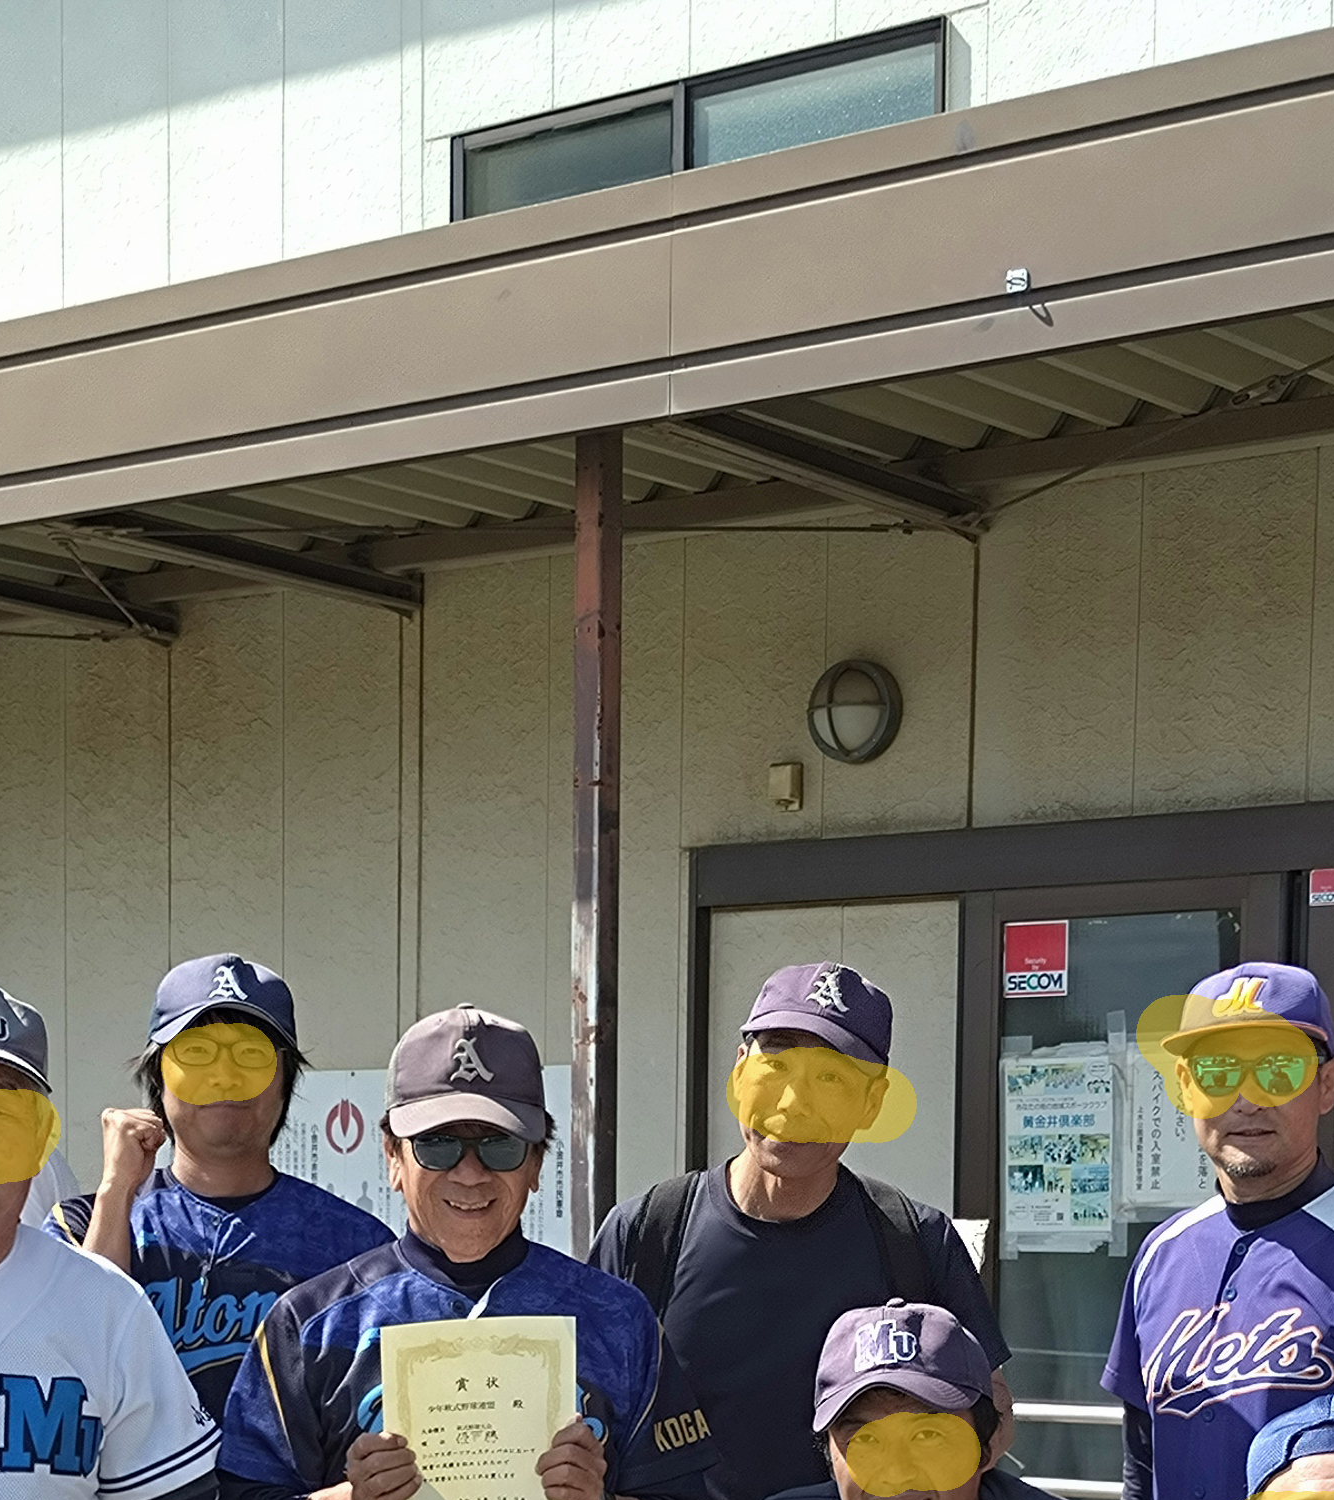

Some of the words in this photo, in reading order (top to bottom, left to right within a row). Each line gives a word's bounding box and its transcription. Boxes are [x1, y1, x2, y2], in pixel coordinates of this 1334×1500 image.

[1024, 957, 1047, 966] Security
[208, 965, 250, 1001] A
[1007, 973, 1063, 991] SECOM
[449, 1037, 495, 1083] A
[1022, 1113, 1096, 1128] 黄金井倶楽部
[1143, 1305, 1329, 1402] Mets
[654, 1409, 712, 1452] KOGA
